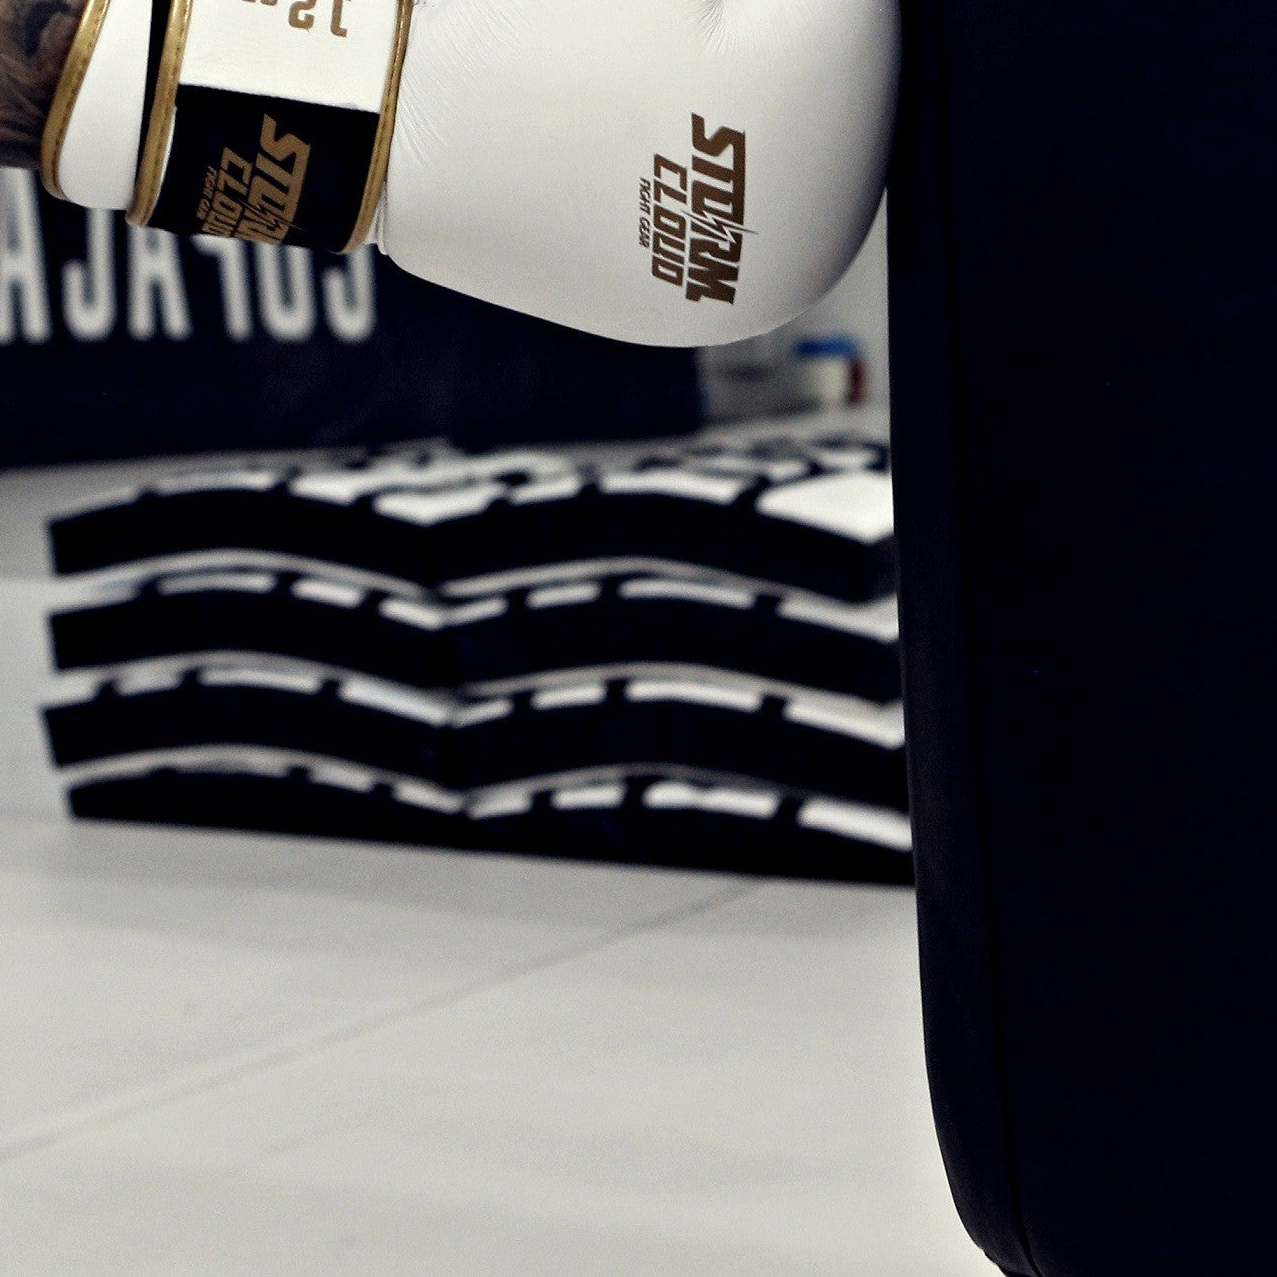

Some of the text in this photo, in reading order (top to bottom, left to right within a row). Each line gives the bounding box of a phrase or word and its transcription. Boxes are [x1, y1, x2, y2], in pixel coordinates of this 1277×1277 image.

[233, 113, 311, 245] STOR
[638, 177, 652, 249] FIGHT GEAR
[651, 153, 688, 287] CLOUD
[685, 112, 748, 305] STORM
